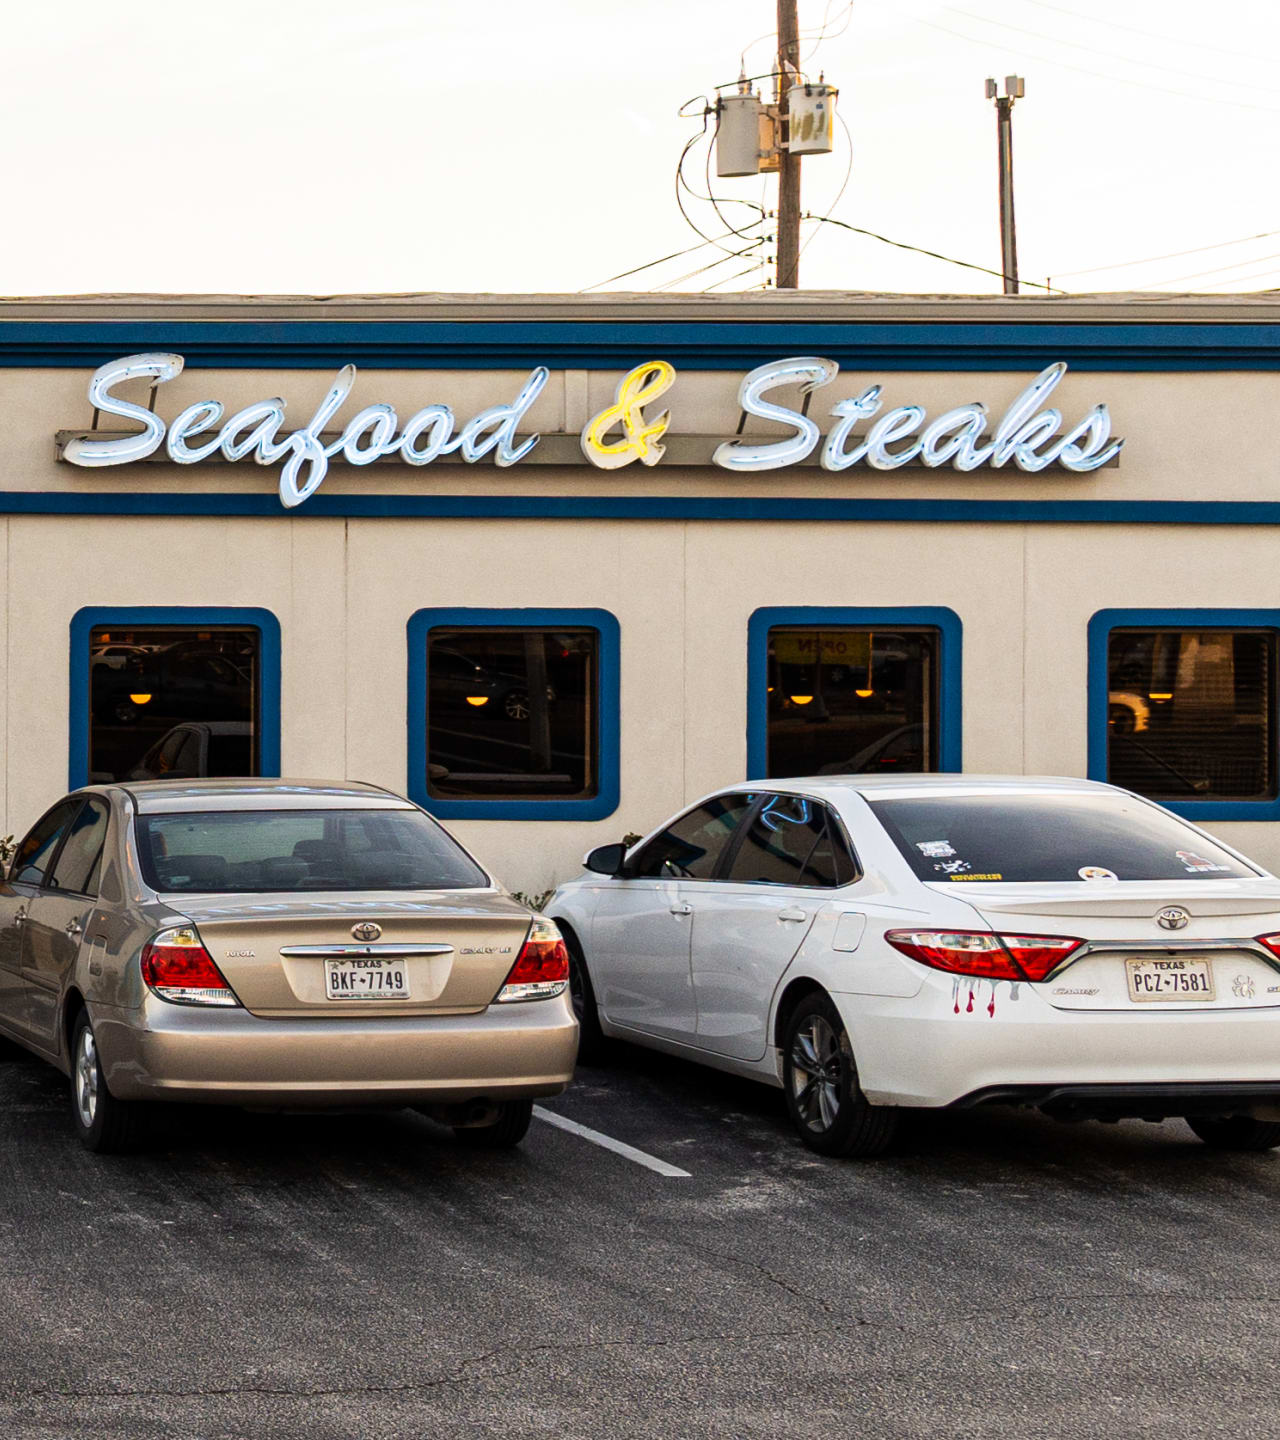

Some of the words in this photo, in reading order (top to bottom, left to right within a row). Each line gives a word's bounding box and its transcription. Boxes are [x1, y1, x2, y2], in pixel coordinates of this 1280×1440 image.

[63, 354, 550, 510] Seafood
[584, 360, 675, 470] &
[712, 356, 1125, 473] Steaks
[350, 960, 382, 969] TEXAS
[1153, 961, 1186, 971] TEXAS
